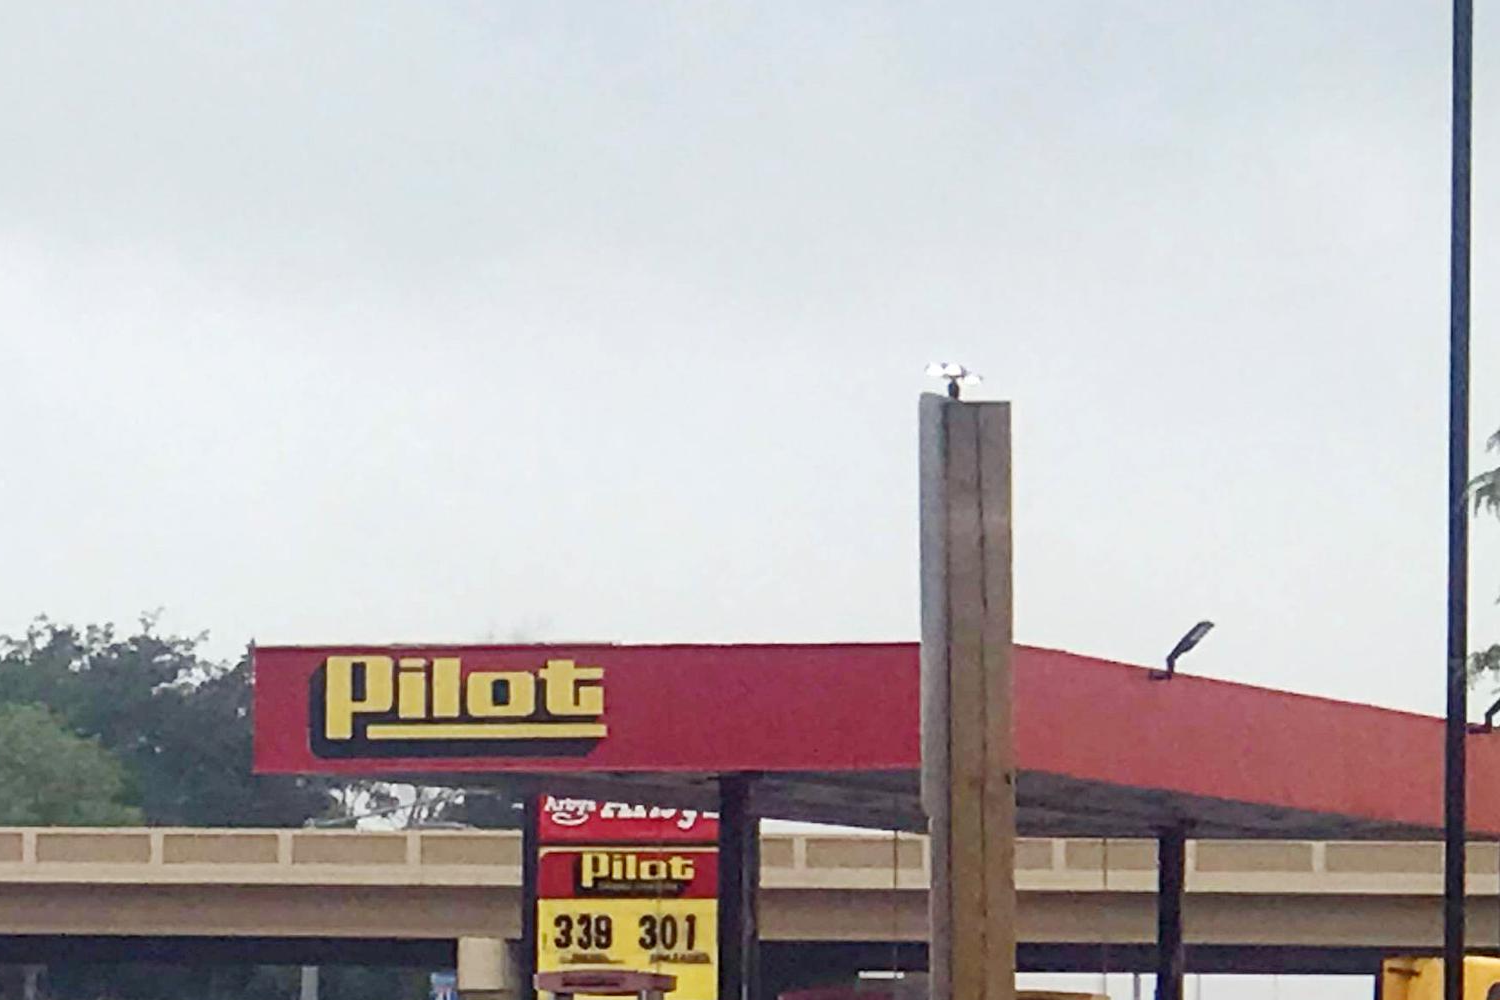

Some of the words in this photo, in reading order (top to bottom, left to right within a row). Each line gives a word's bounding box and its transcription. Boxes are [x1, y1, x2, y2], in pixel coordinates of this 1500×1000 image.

[325, 655, 604, 740] Pilot
[581, 852, 695, 888] Pilot
[554, 914, 612, 950] 339
[638, 914, 696, 950] 301
